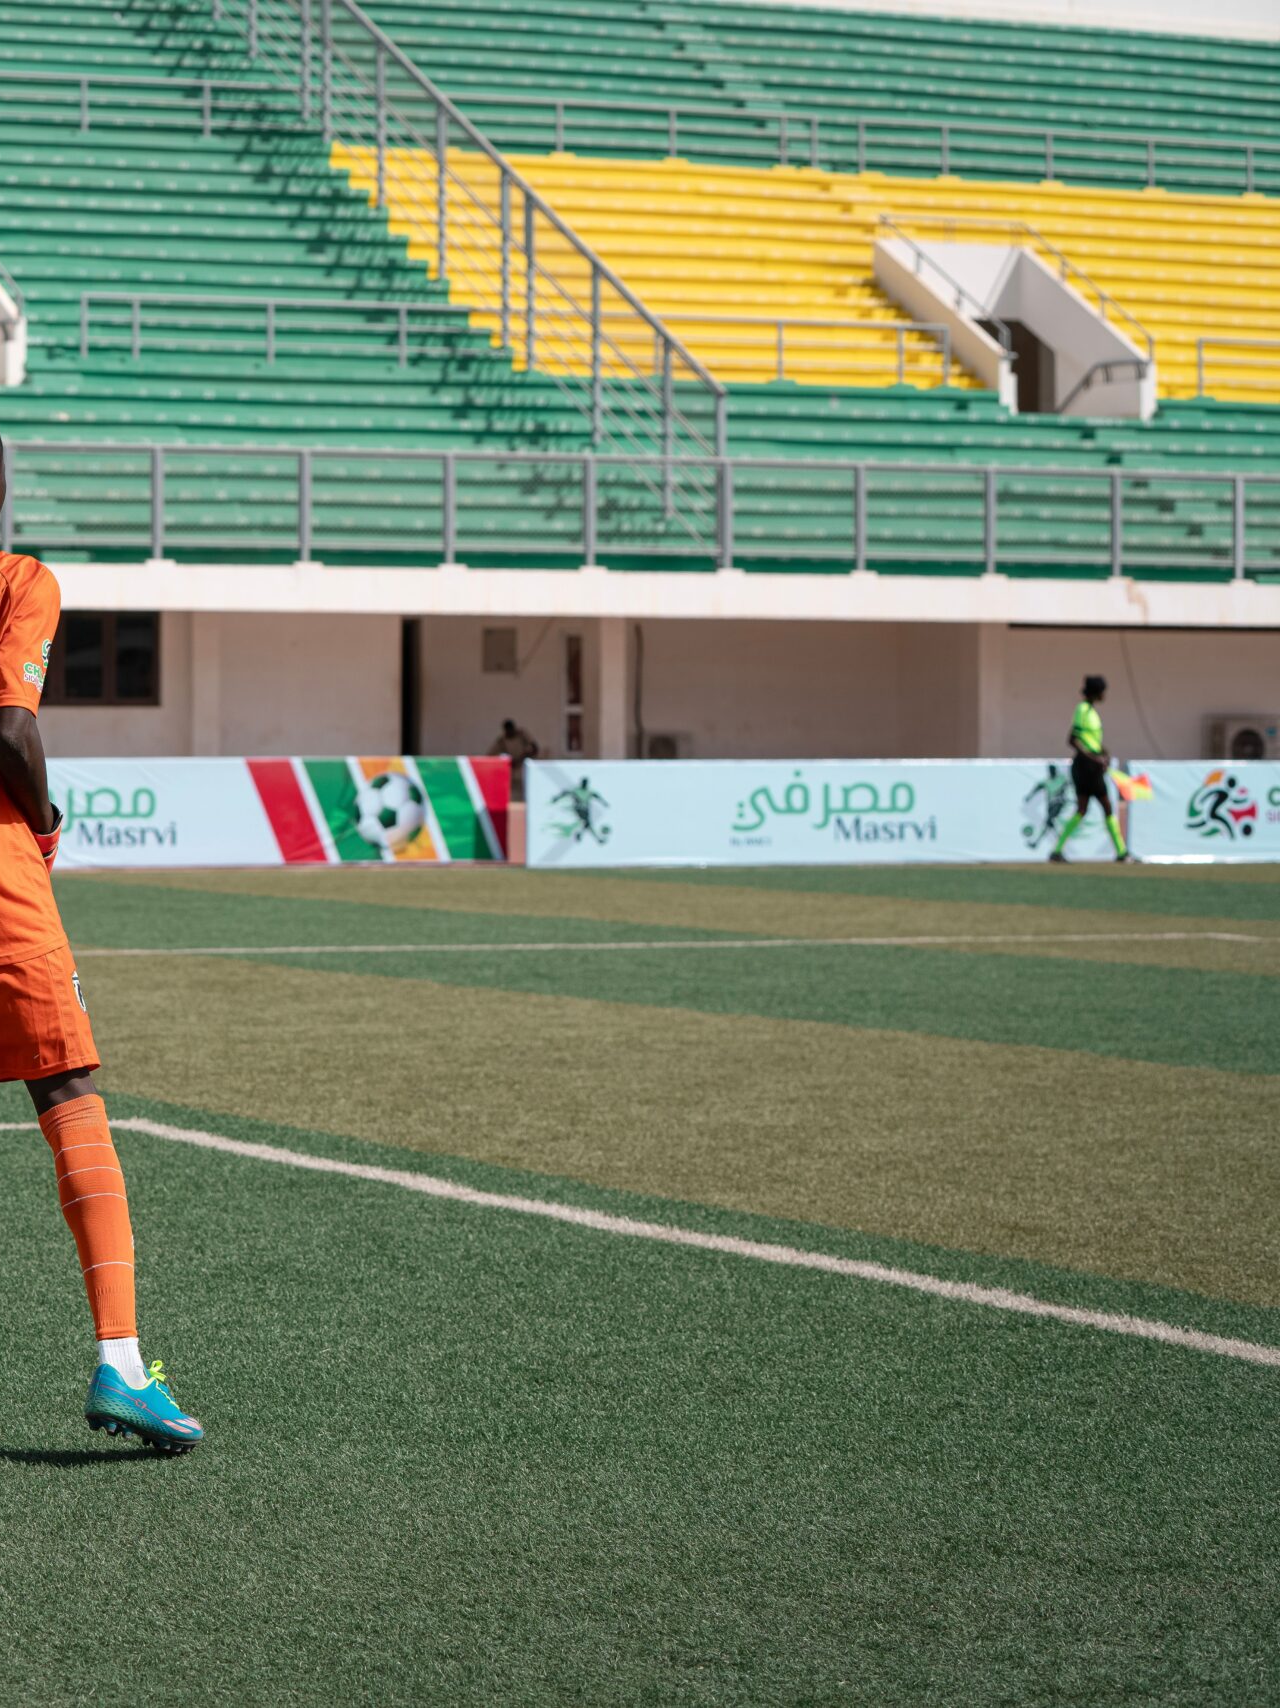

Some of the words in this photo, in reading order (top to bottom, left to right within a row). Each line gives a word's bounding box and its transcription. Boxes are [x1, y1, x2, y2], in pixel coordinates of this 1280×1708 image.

[731, 769, 915, 832] مصرفي
[78, 820, 177, 847] Masrvi
[833, 815, 937, 843] Masrvi
